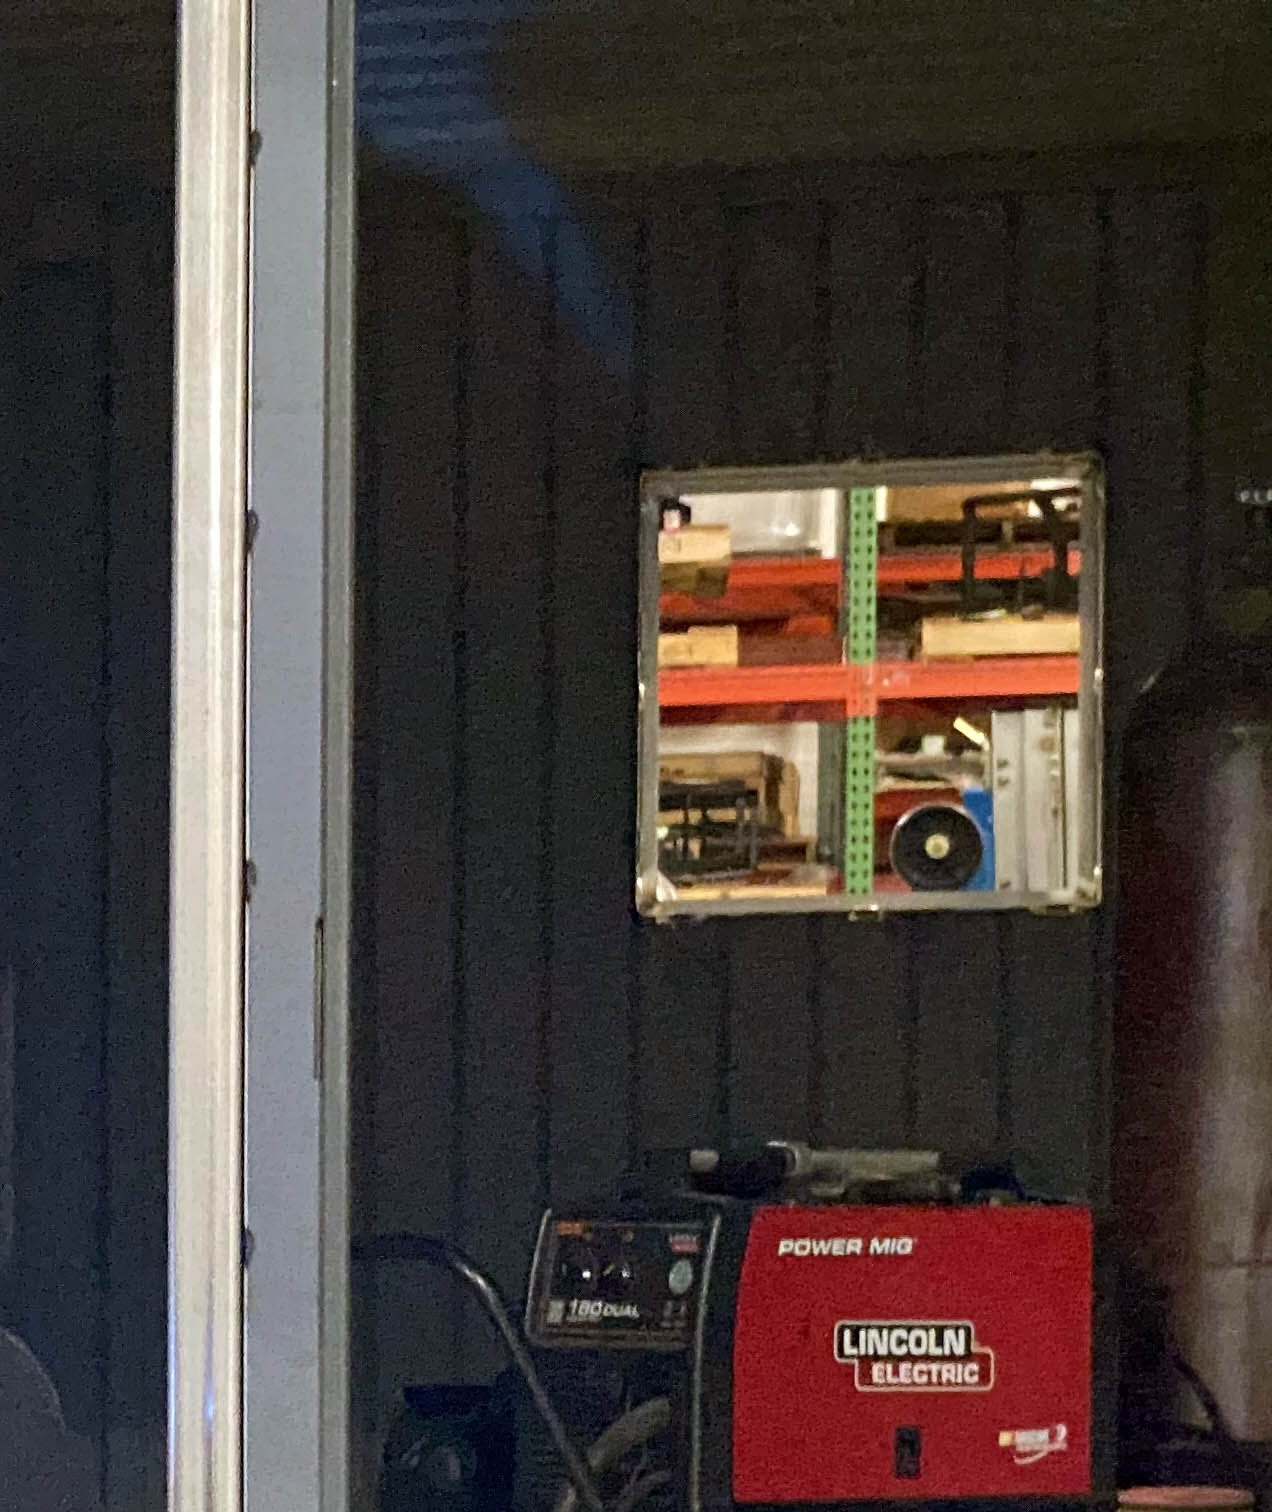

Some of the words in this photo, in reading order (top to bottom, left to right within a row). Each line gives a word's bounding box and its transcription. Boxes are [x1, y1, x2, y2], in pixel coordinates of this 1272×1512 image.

[778, 1237, 862, 1257] POWER
[869, 1237, 915, 1256] MIG
[843, 1327, 966, 1356] LINCOLN
[871, 1361, 980, 1384] ELECTRIC
